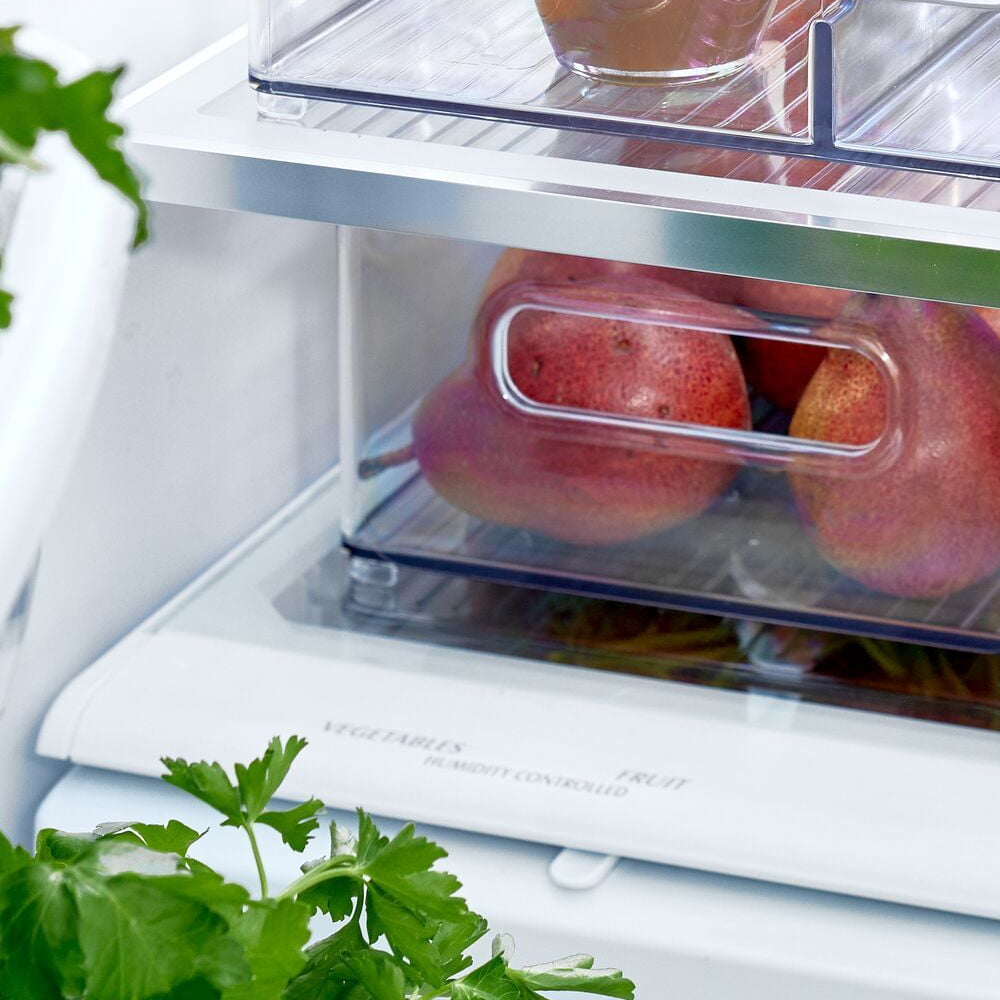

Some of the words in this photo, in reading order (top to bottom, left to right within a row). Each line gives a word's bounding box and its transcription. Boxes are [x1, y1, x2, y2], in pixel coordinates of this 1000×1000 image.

[321, 719, 466, 755] VEGETABLES
[423, 755, 512, 780] HUMIDITY
[514, 768, 630, 799] CONTROLLED
[614, 768, 692, 792] FRUIT
